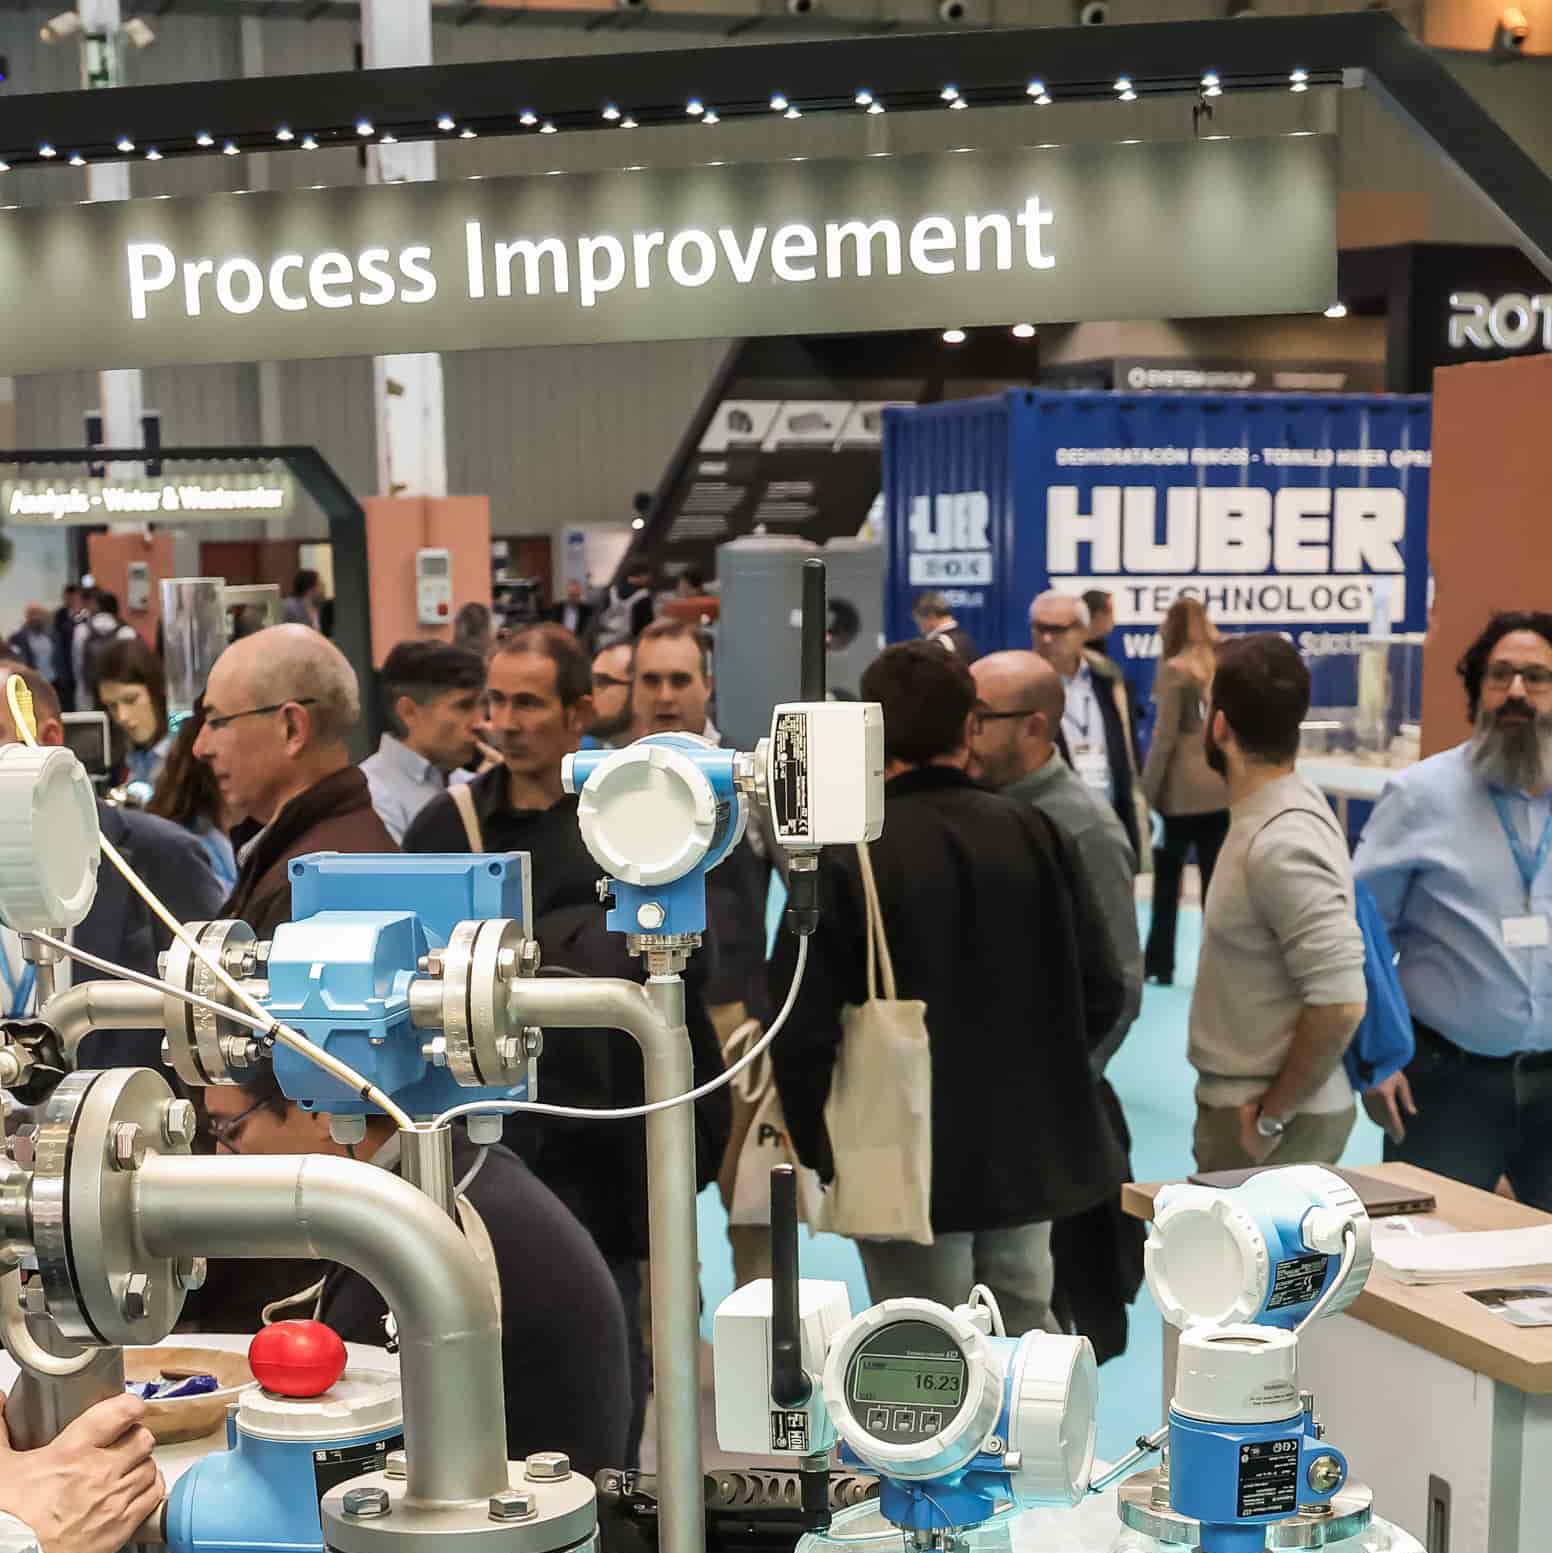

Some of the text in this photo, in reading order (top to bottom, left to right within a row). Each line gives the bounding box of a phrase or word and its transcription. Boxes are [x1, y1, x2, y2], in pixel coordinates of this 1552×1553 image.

[127, 197, 1056, 319] Process Improvement
[9, 488, 90, 519] Analysis
[102, 487, 161, 511] Water
[161, 486, 180, 510] &
[179, 485, 284, 510] Wastewater
[1046, 486, 1406, 574] HUBER
[914, 1374, 960, 1392] 16.23
